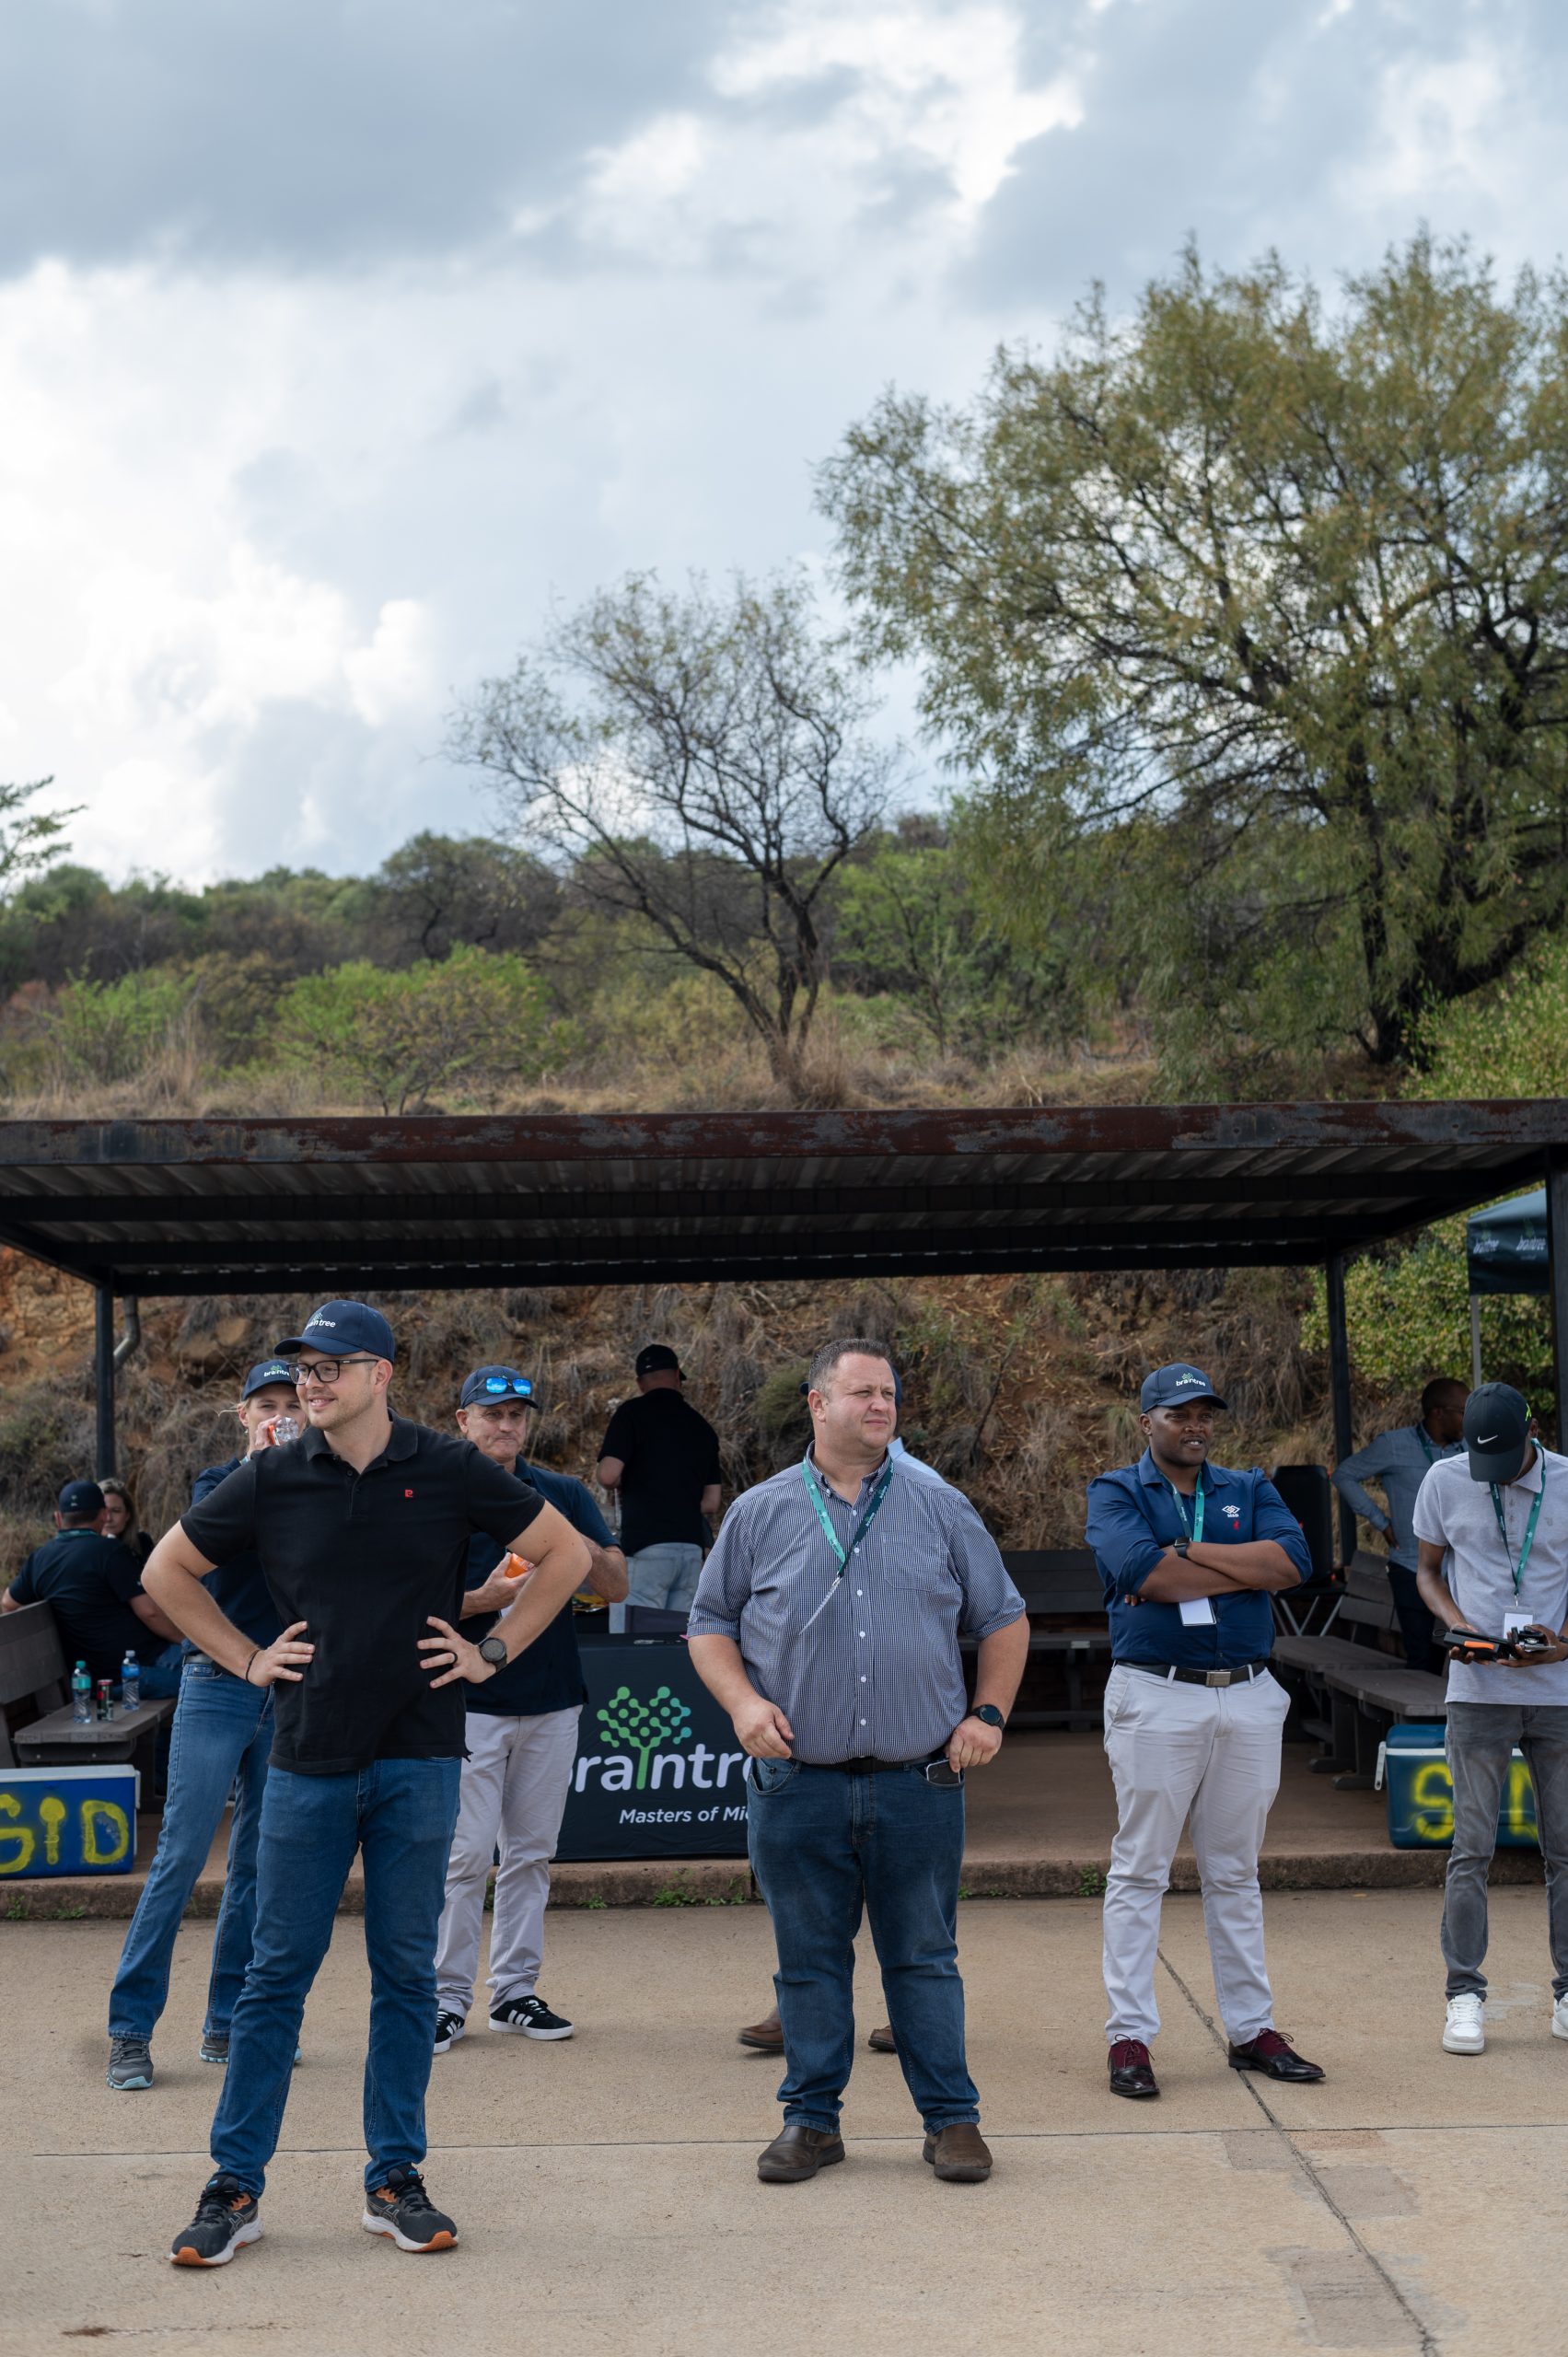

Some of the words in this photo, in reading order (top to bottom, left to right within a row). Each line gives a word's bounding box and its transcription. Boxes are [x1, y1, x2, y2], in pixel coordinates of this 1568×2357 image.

[568, 1743, 752, 1793] raintr
[619, 1808, 691, 1824] Masters
[697, 1806, 719, 1822] of
